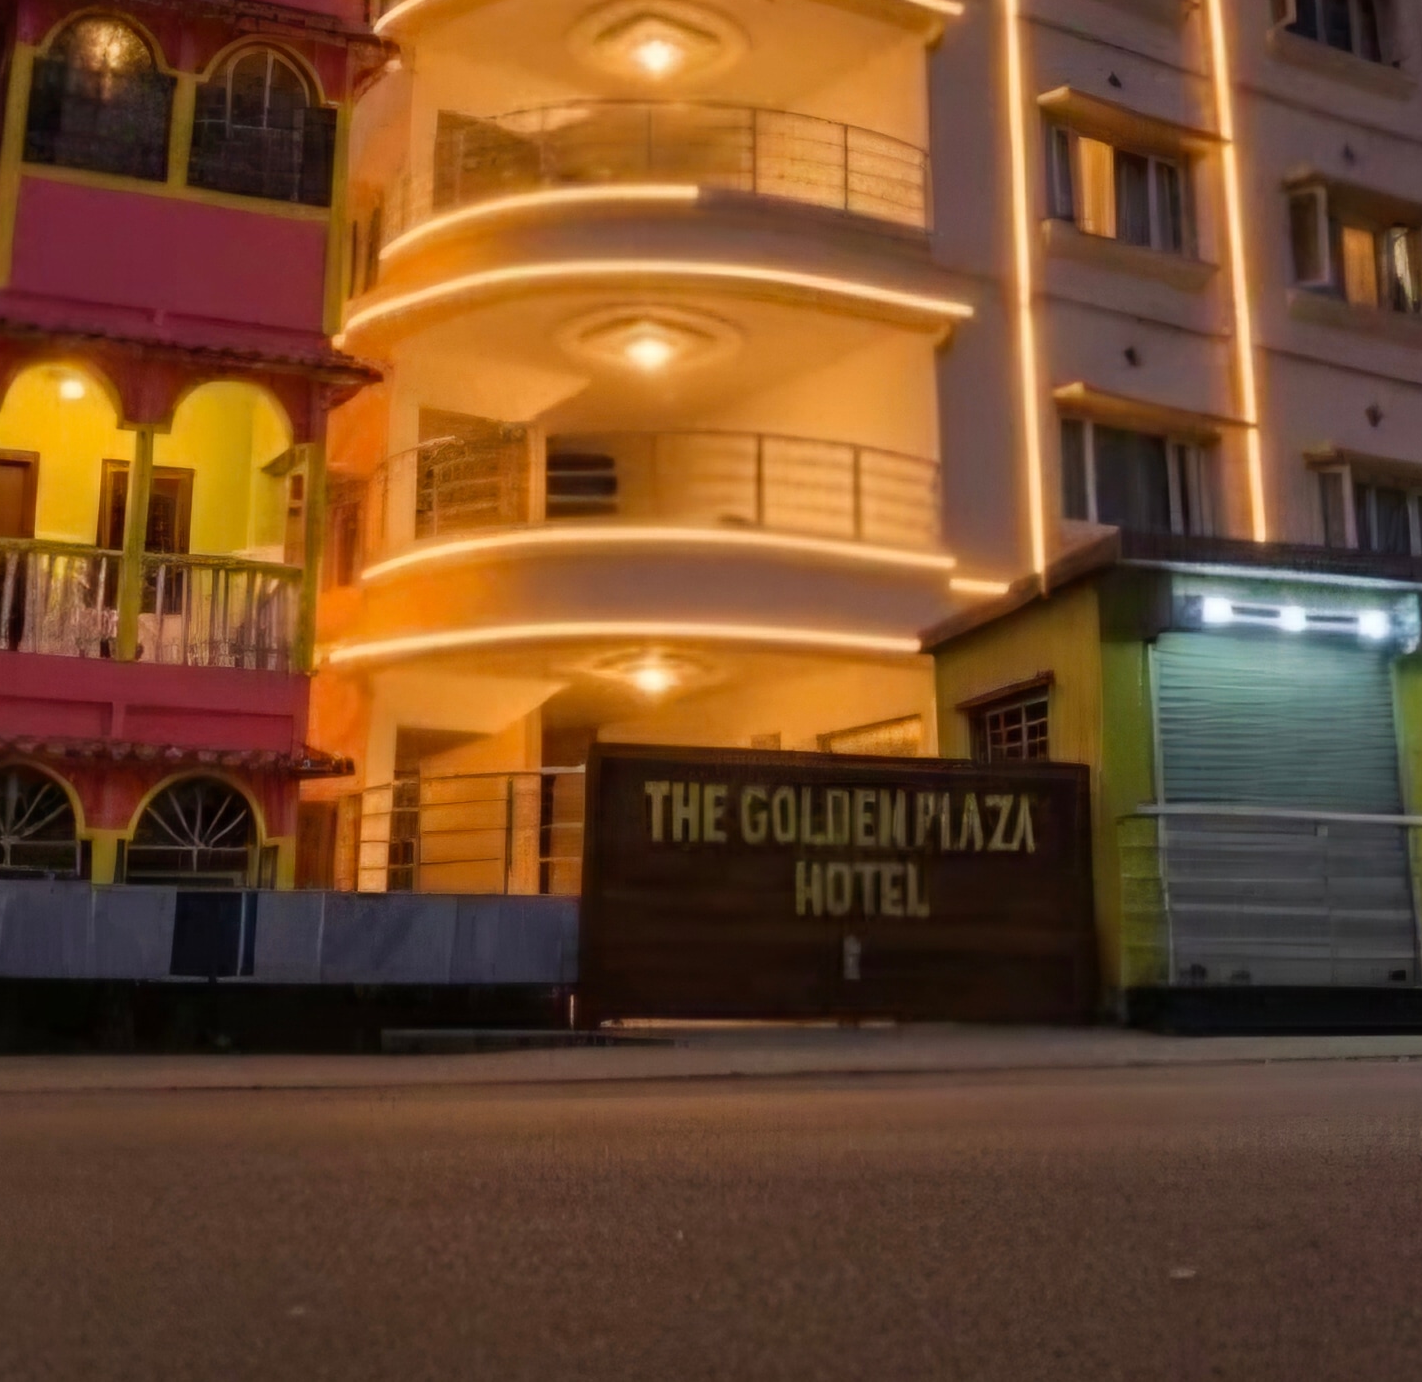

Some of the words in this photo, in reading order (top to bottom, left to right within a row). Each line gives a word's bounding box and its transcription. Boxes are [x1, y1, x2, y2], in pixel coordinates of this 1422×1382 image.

[644, 780, 727, 843] THE
[740, 785, 907, 849] GOLDEN
[915, 791, 1036, 854] PLAZA
[795, 861, 930, 918] HOTEL
